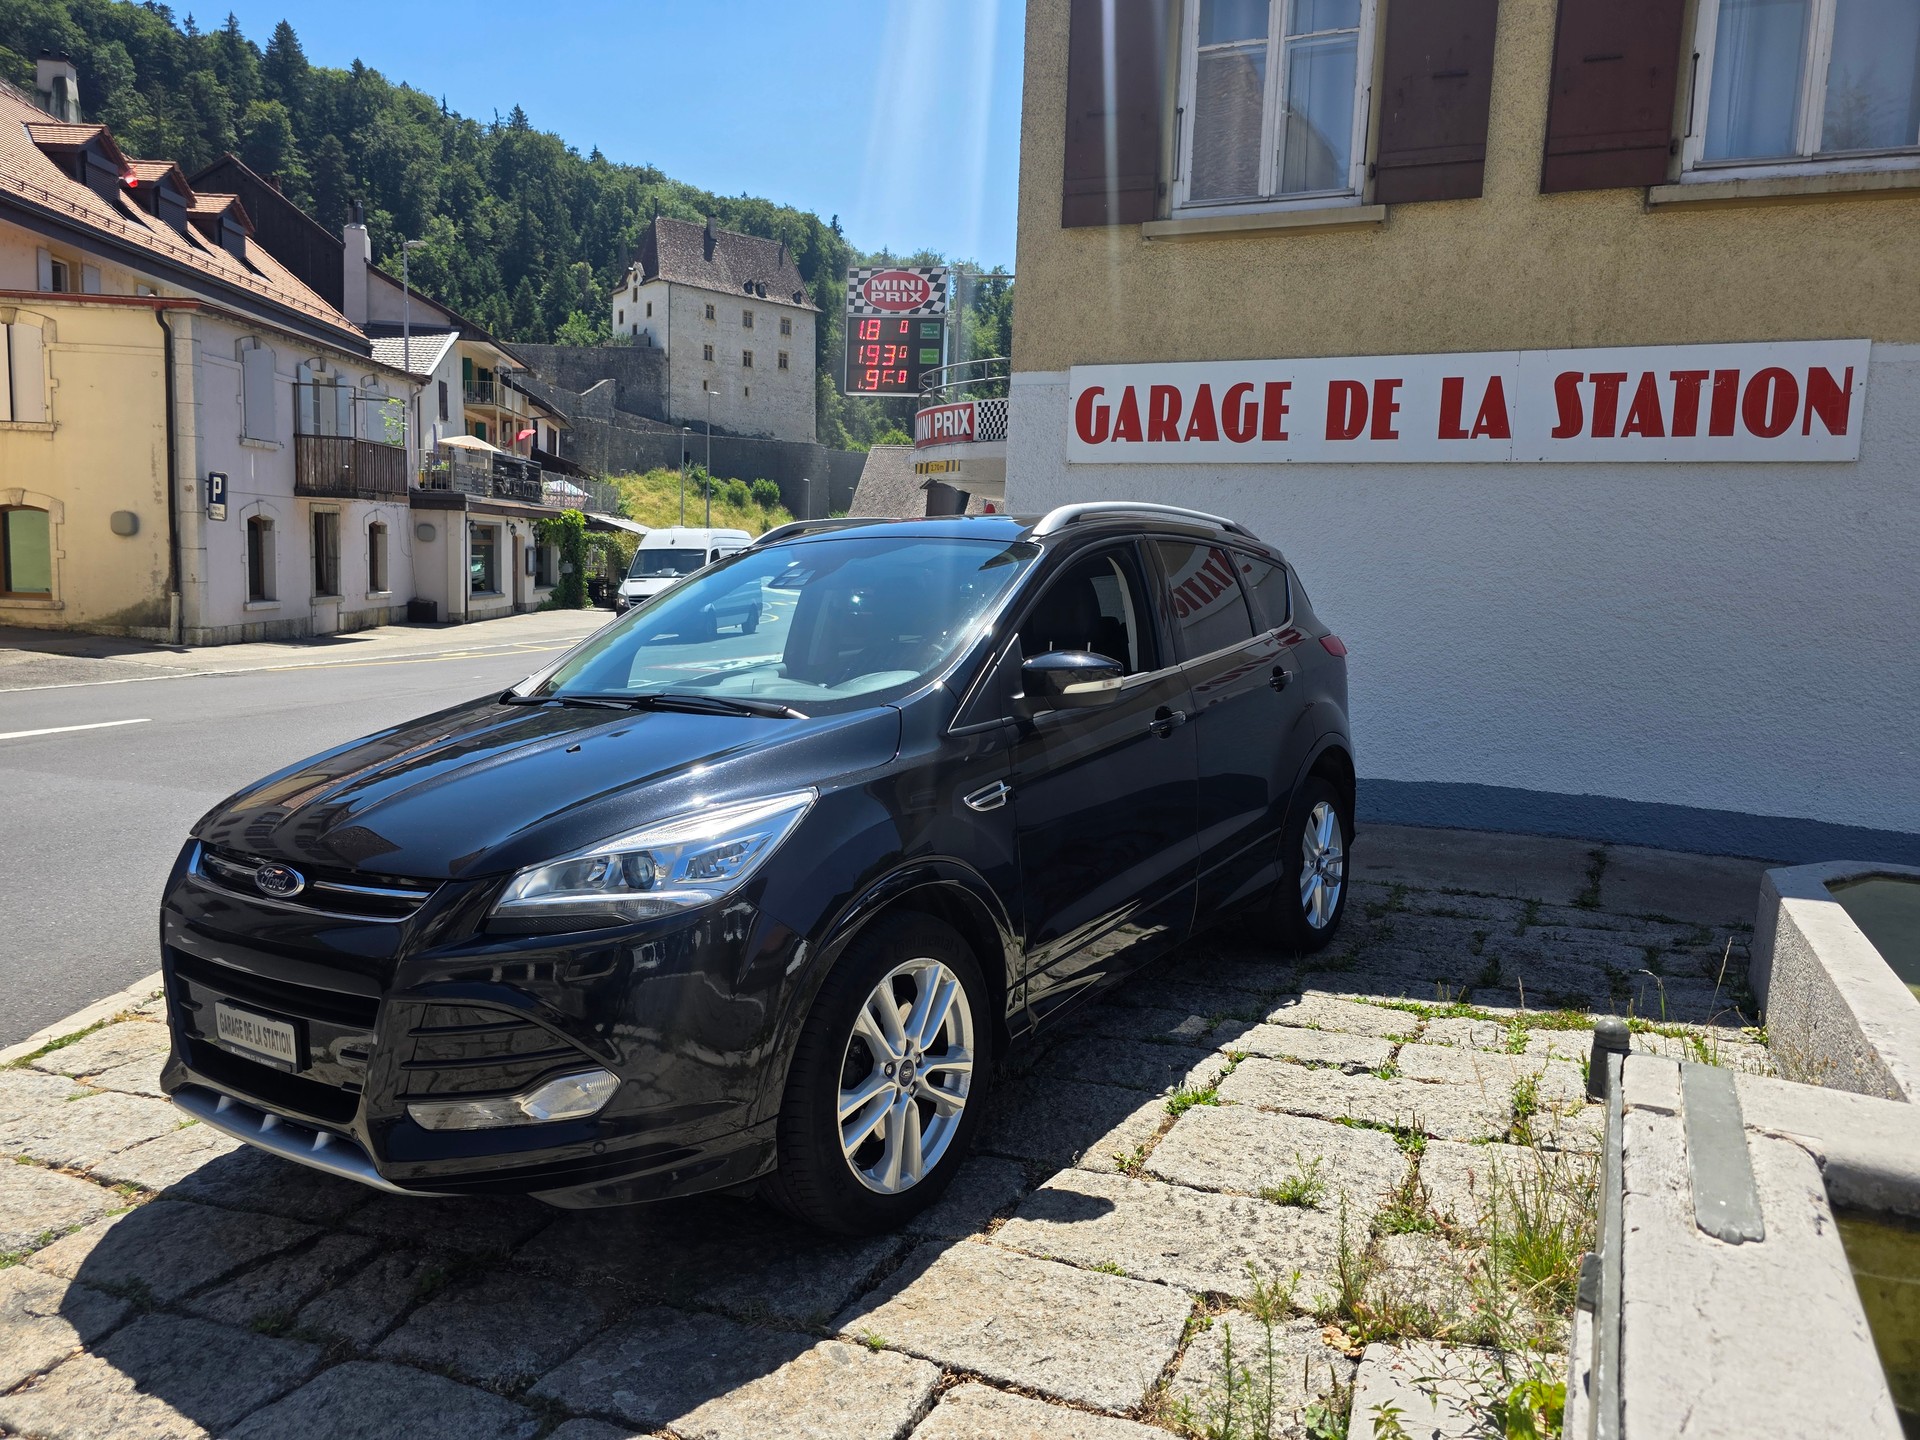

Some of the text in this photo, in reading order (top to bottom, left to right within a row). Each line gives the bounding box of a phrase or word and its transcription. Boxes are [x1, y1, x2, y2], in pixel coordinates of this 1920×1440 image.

[870, 291, 923, 302] PRIX
[871, 279, 923, 291] MINI
[1075, 366, 1854, 444] GARAGE DE LA STATION
[934, 408, 972, 438] PRIX
[213, 476, 222, 502] P
[261, 867, 289, 890] Ford
[219, 1012, 292, 1055] GARAGE DE LA STATION
